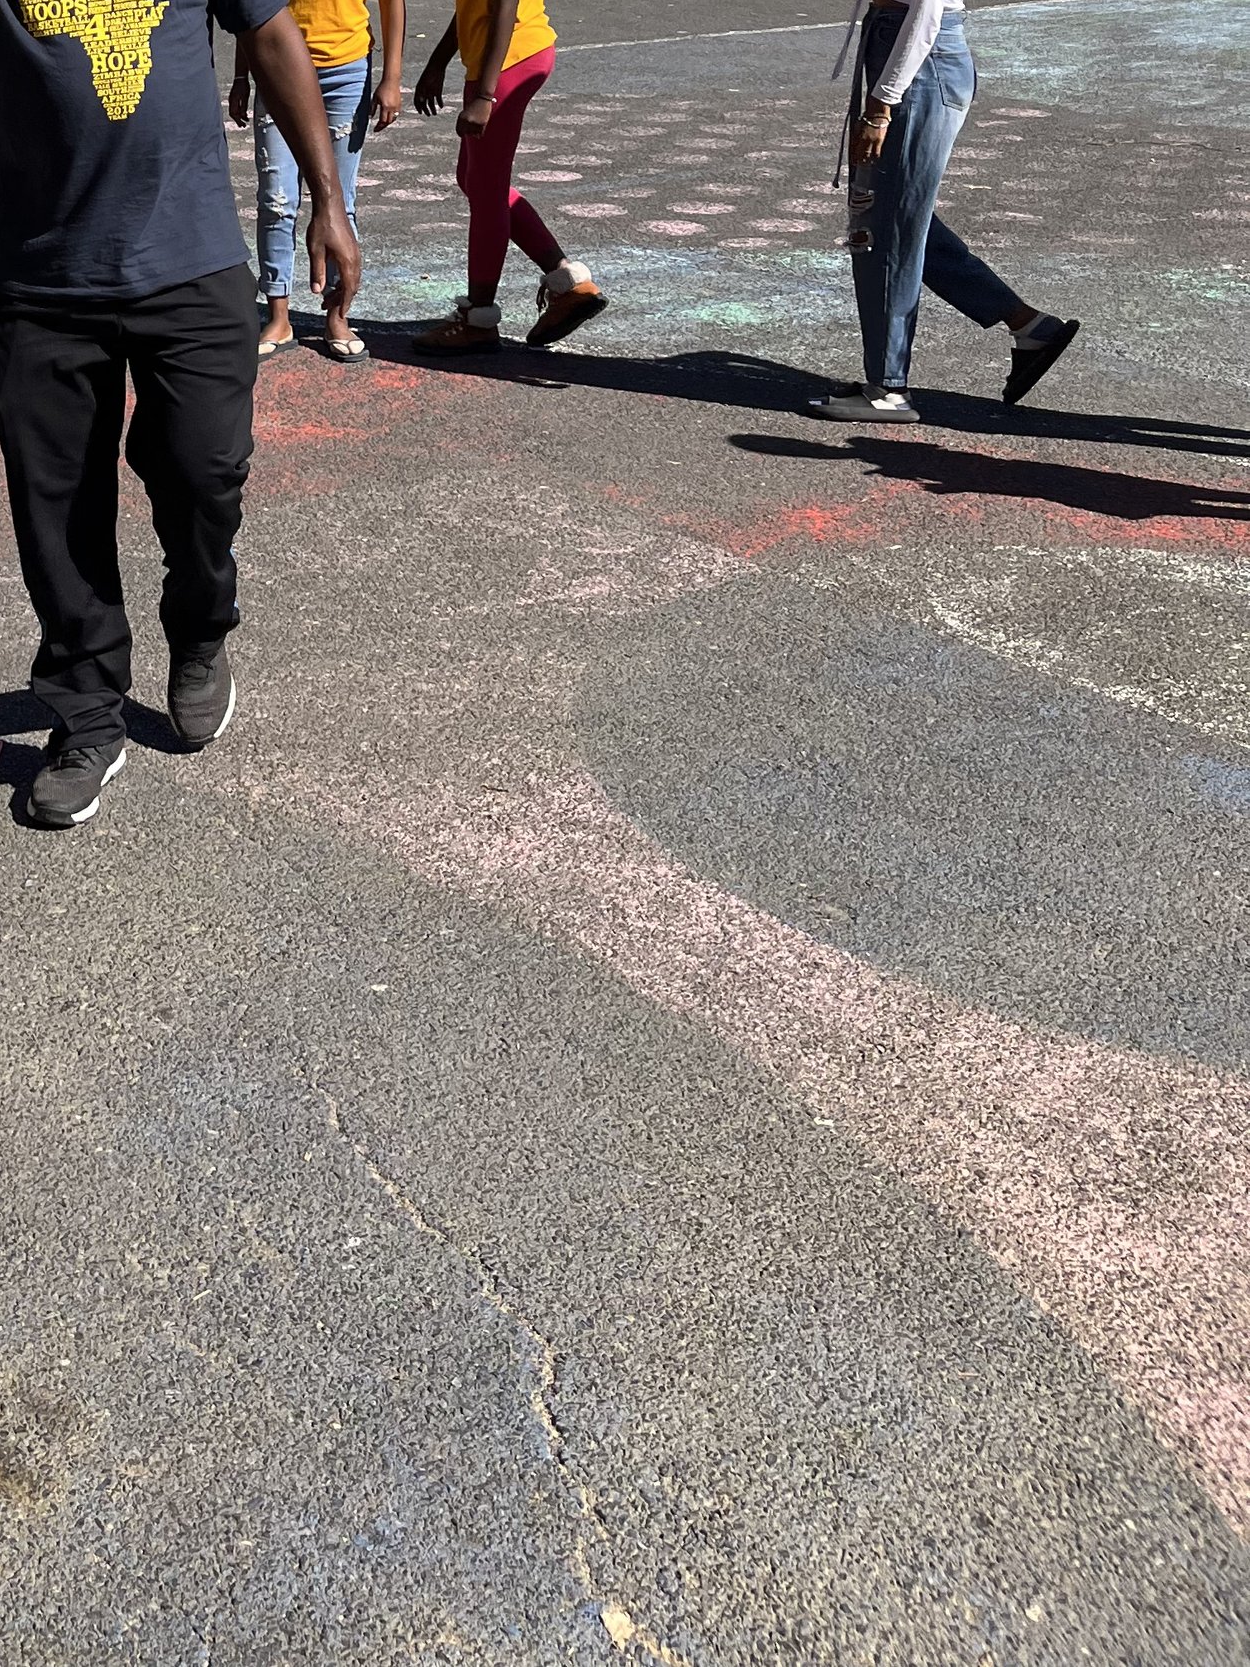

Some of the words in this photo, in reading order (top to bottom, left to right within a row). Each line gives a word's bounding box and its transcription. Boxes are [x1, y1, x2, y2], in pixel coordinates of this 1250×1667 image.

[133, 6, 165, 23] PLAY
[28, 15, 90, 31] BASKETBALL
[85, 13, 110, 40] 4
[84, 35, 150, 50] LEADERSHIP
[91, 48, 152, 74] HOPE
[101, 92, 141, 103] AFRICA
